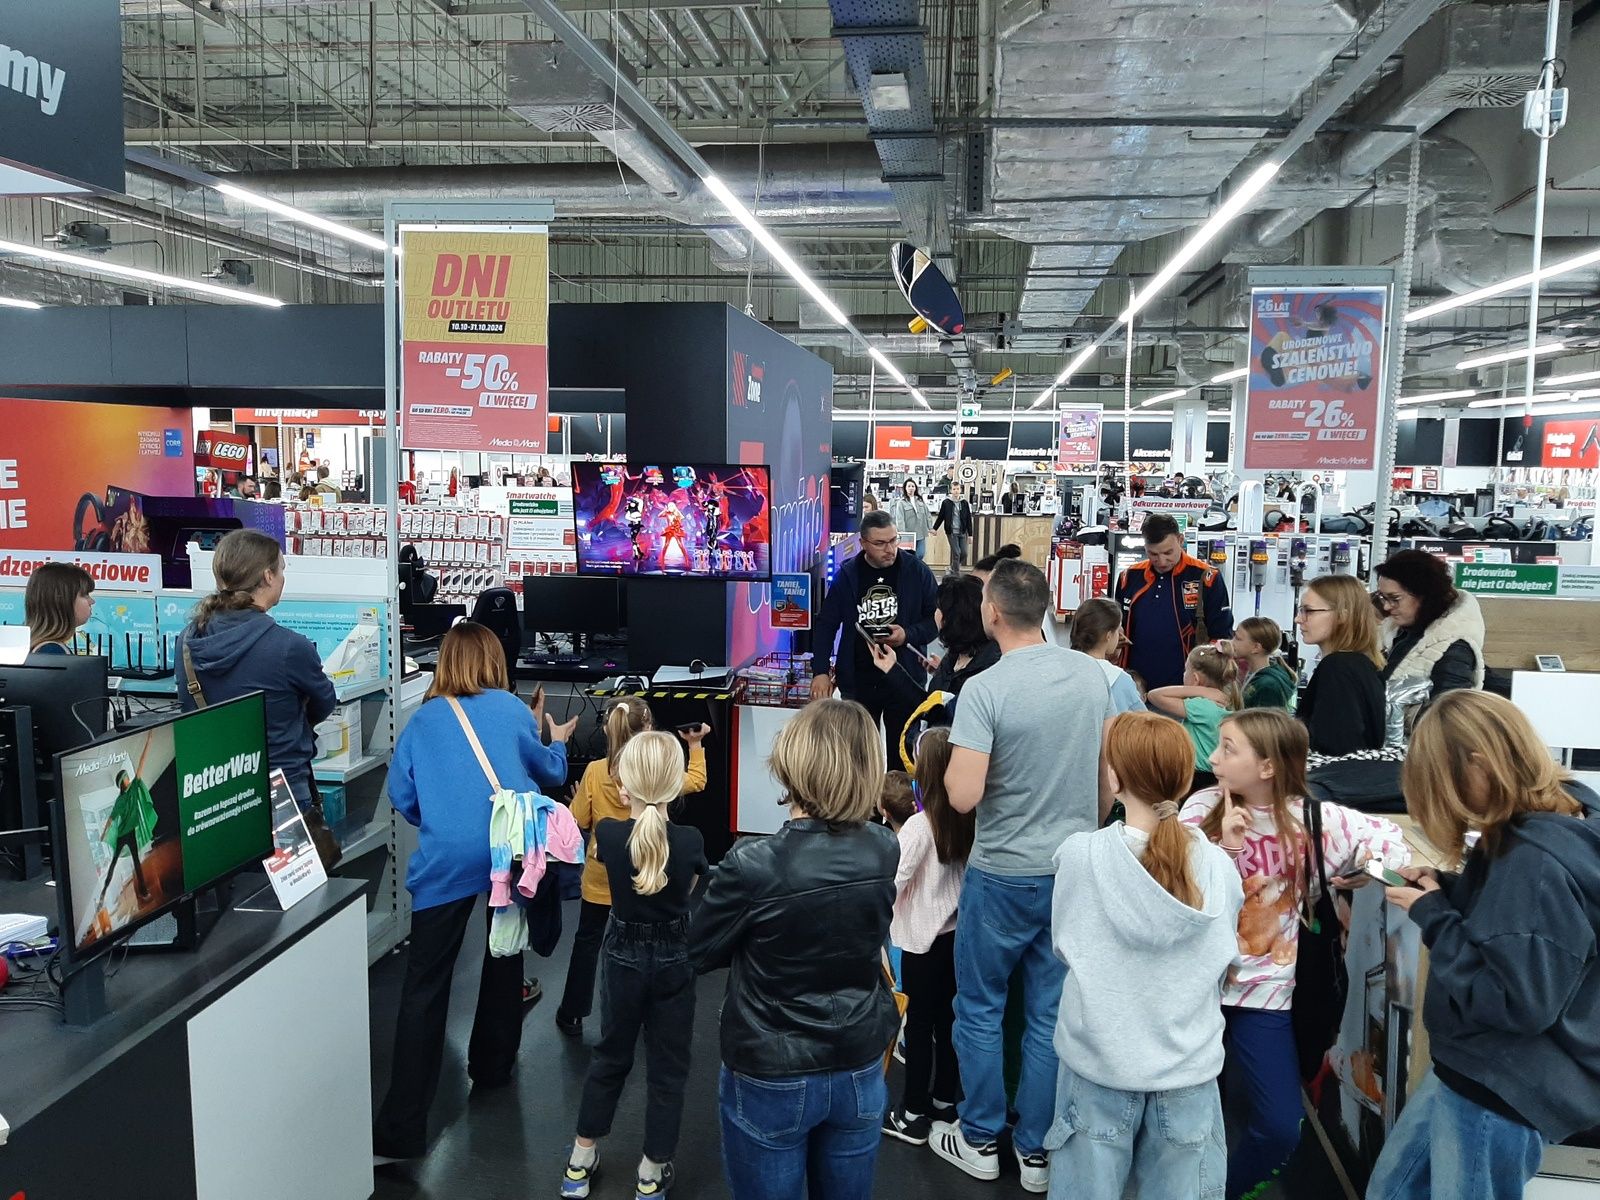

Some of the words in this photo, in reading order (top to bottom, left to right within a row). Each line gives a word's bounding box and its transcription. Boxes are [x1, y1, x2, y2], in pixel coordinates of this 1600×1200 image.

[431, 254, 511, 298] DNI
[427, 300, 511, 320] OUTLETU
[1258, 299, 1274, 311] 26
[1274, 302, 1290, 312] LAT
[451, 323, 504, 332] 10.10-31.10.2024
[1282, 334, 1343, 350] URODZINOWE
[418, 351, 463, 364] RABATY
[445, 354, 519, 391] -50%
[1288, 361, 1359, 384] CENOWE!
[747, 376, 760, 403] Zone
[486, 395, 491, 405] I
[494, 395, 529, 408] WIĘCEJ
[1269, 399, 1305, 410] RABATY
[1292, 400, 1355, 428] -26%
[488, 438, 513, 448] Media
[519, 439, 540, 448] Markt
[1323, 431, 1329, 439] I
[1330, 431, 1361, 441] WIĘCEJ
[214, 442, 247, 460] LEGO
[506, 492, 556, 500] Smartwatche
[1461, 566, 1518, 577] Środowisko
[1461, 580, 1476, 588] nie
[1476, 580, 1495, 590] jest
[1496, 580, 1505, 588] Ci
[1506, 581, 1553, 591] obojętne?
[857, 596, 897, 613] MISTR
[75, 762, 100, 777] Media
[183, 751, 261, 798] BetterWay
